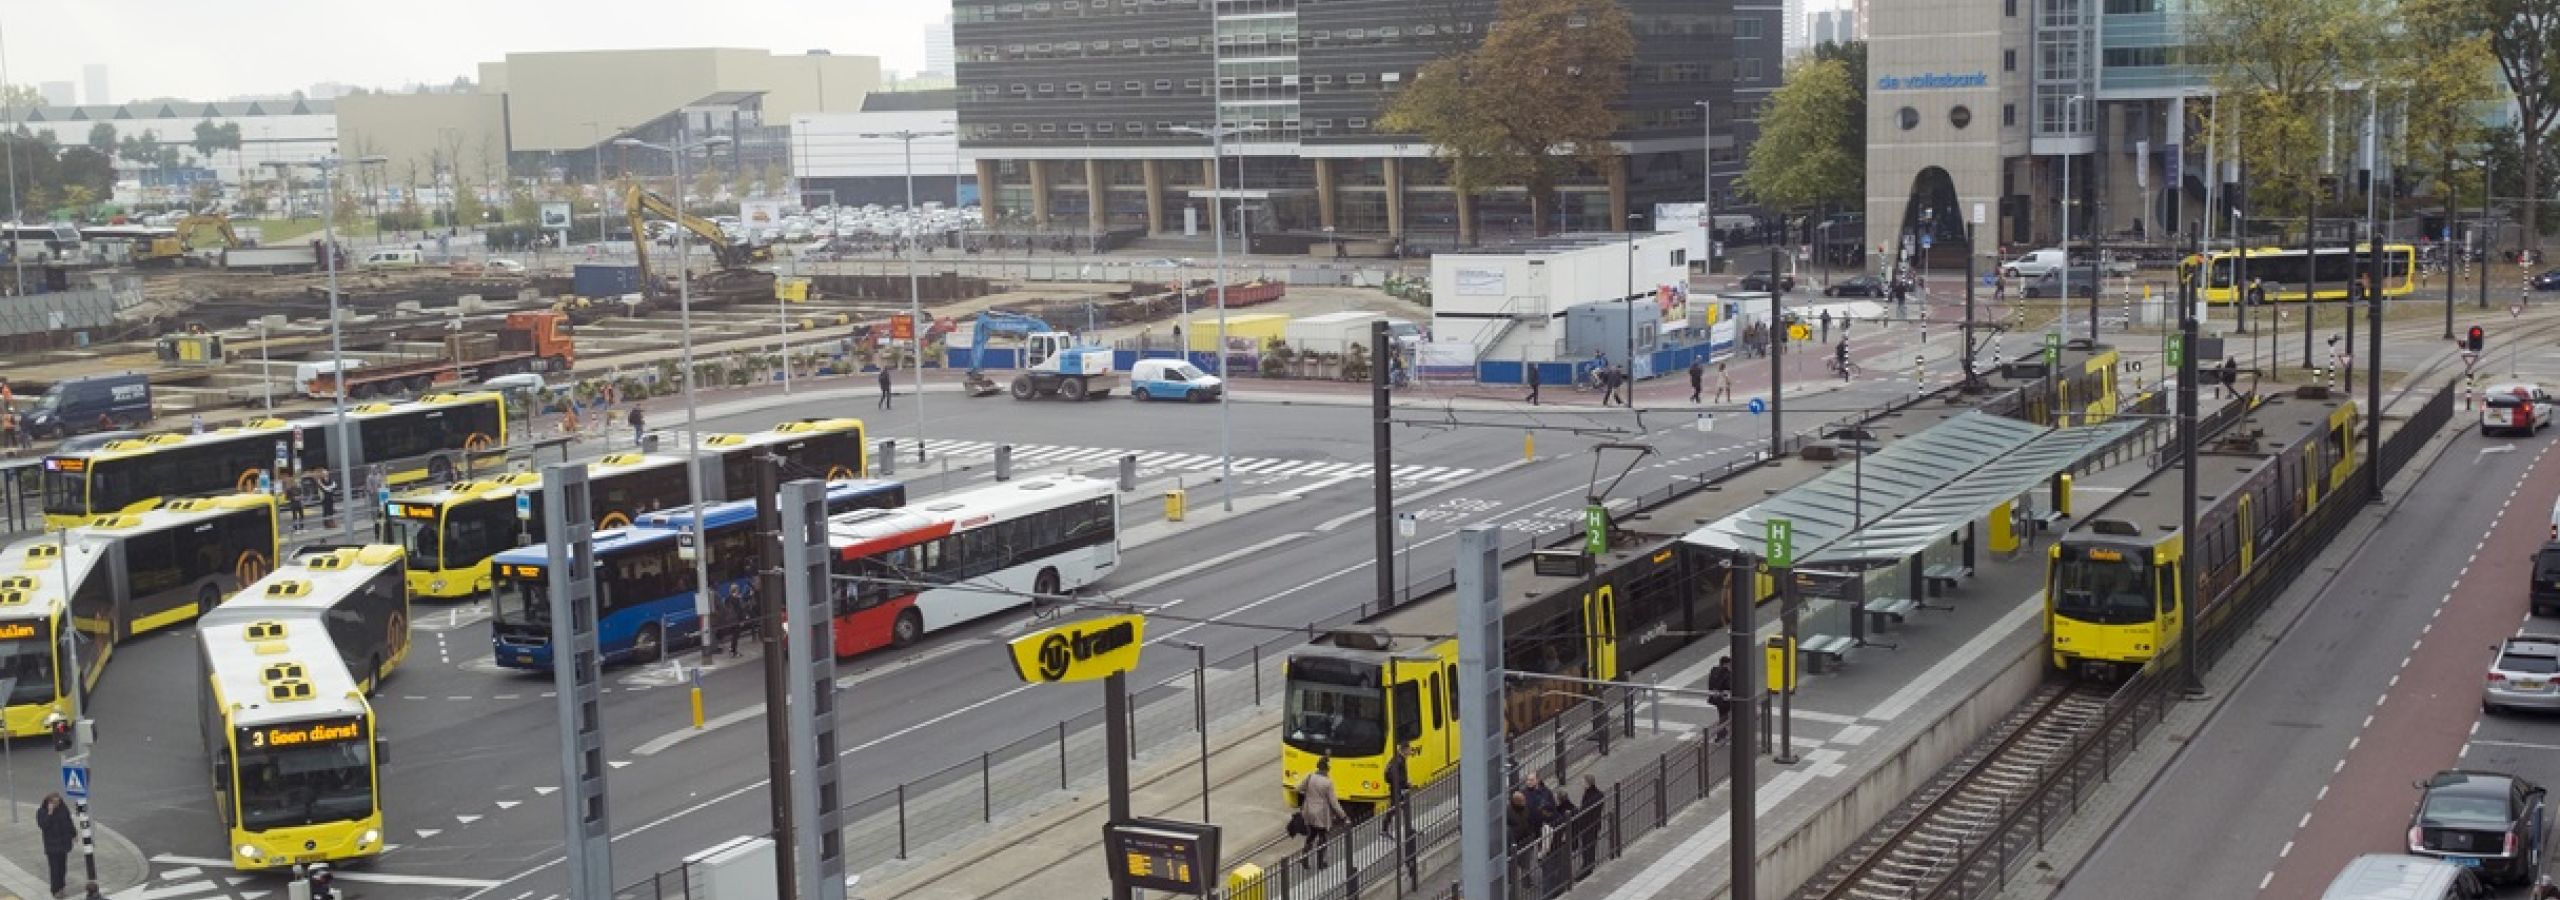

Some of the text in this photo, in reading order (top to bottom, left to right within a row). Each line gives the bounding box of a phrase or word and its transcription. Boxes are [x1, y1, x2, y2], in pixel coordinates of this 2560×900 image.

[1878, 70, 1988, 89] de volksbank
[1590, 511, 1600, 527] H
[1591, 529, 1600, 546] 2
[1771, 523, 1786, 540] H
[1773, 542, 1784, 559] 3
[1071, 620, 1134, 662] tram
[252, 721, 359, 747] 3 Geen dienst
